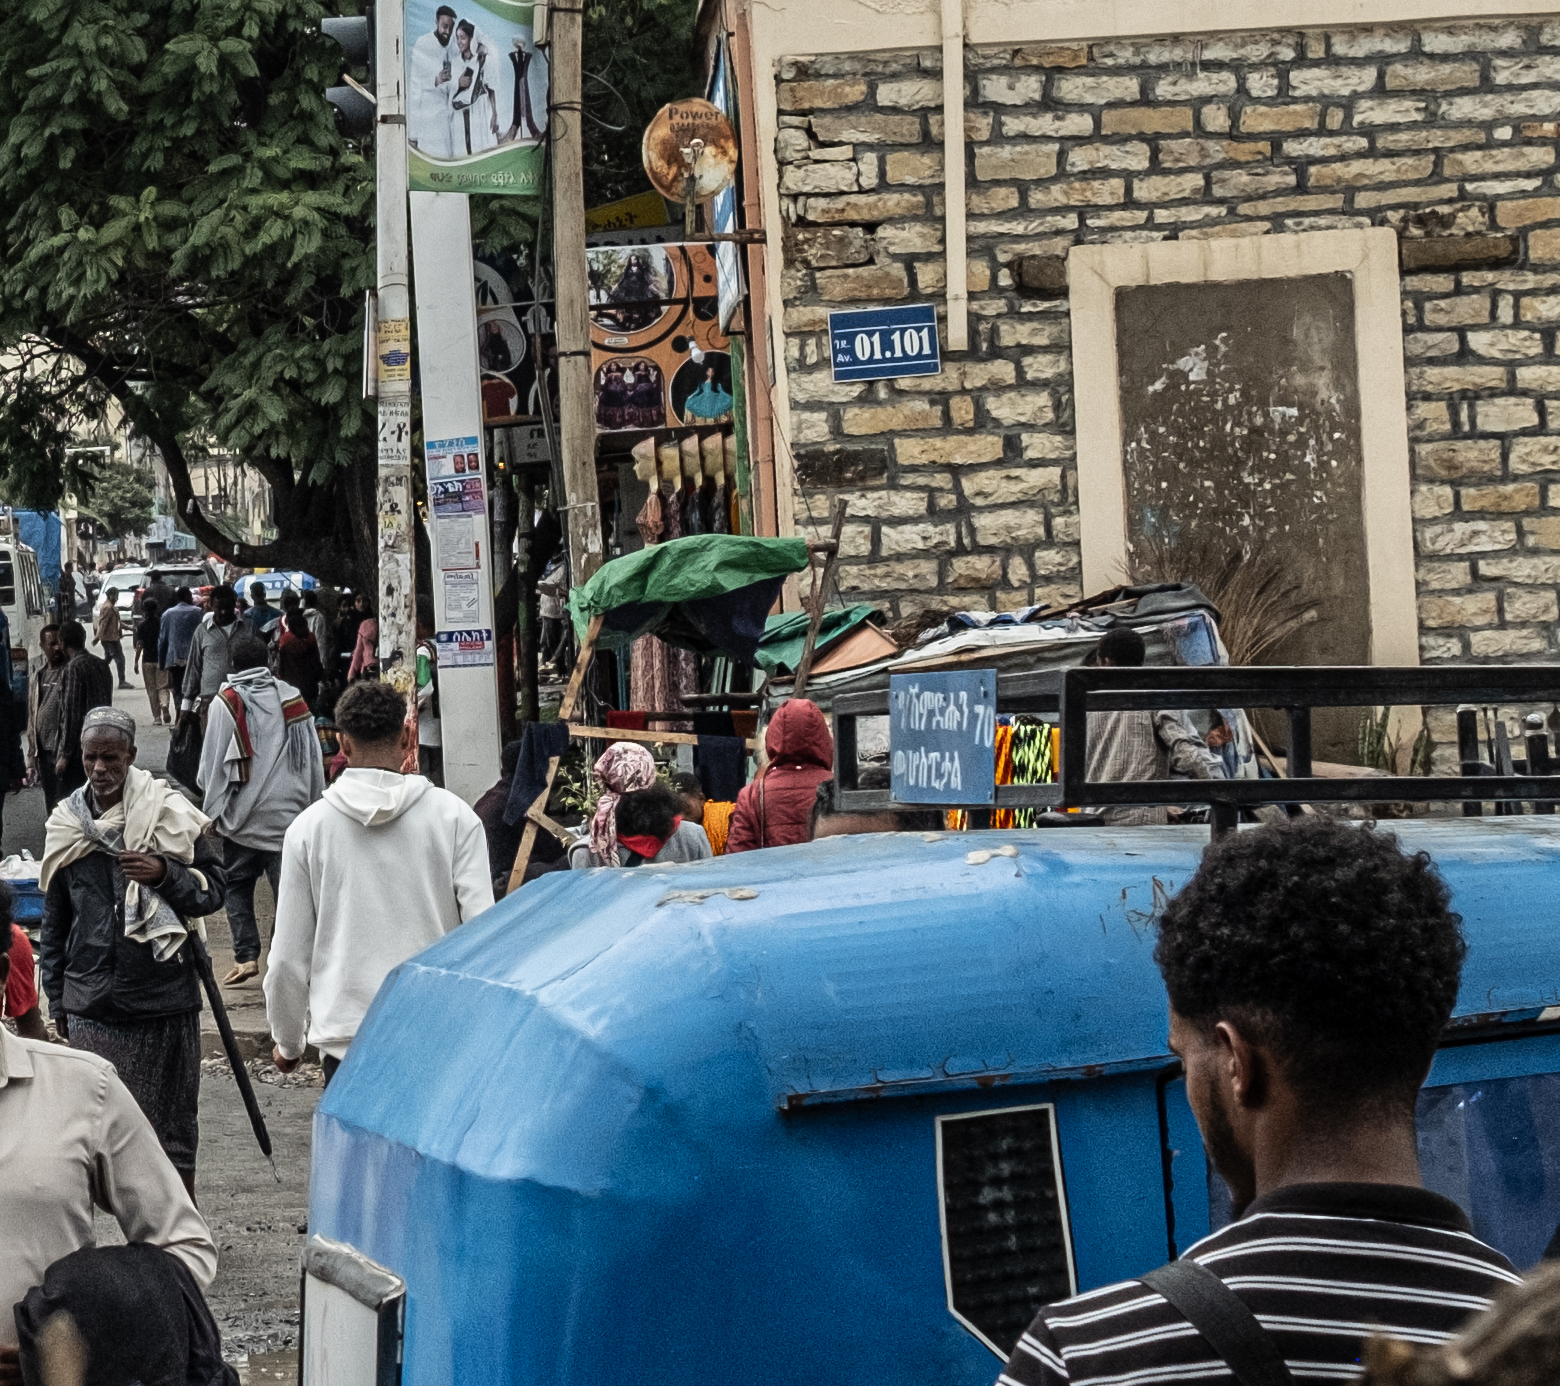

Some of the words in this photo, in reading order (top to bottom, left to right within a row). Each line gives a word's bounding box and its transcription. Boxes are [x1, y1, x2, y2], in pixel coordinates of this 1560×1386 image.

[836, 353, 853, 363] Av.
[854, 326, 932, 362] 01.101
[973, 704, 994, 748] 70
